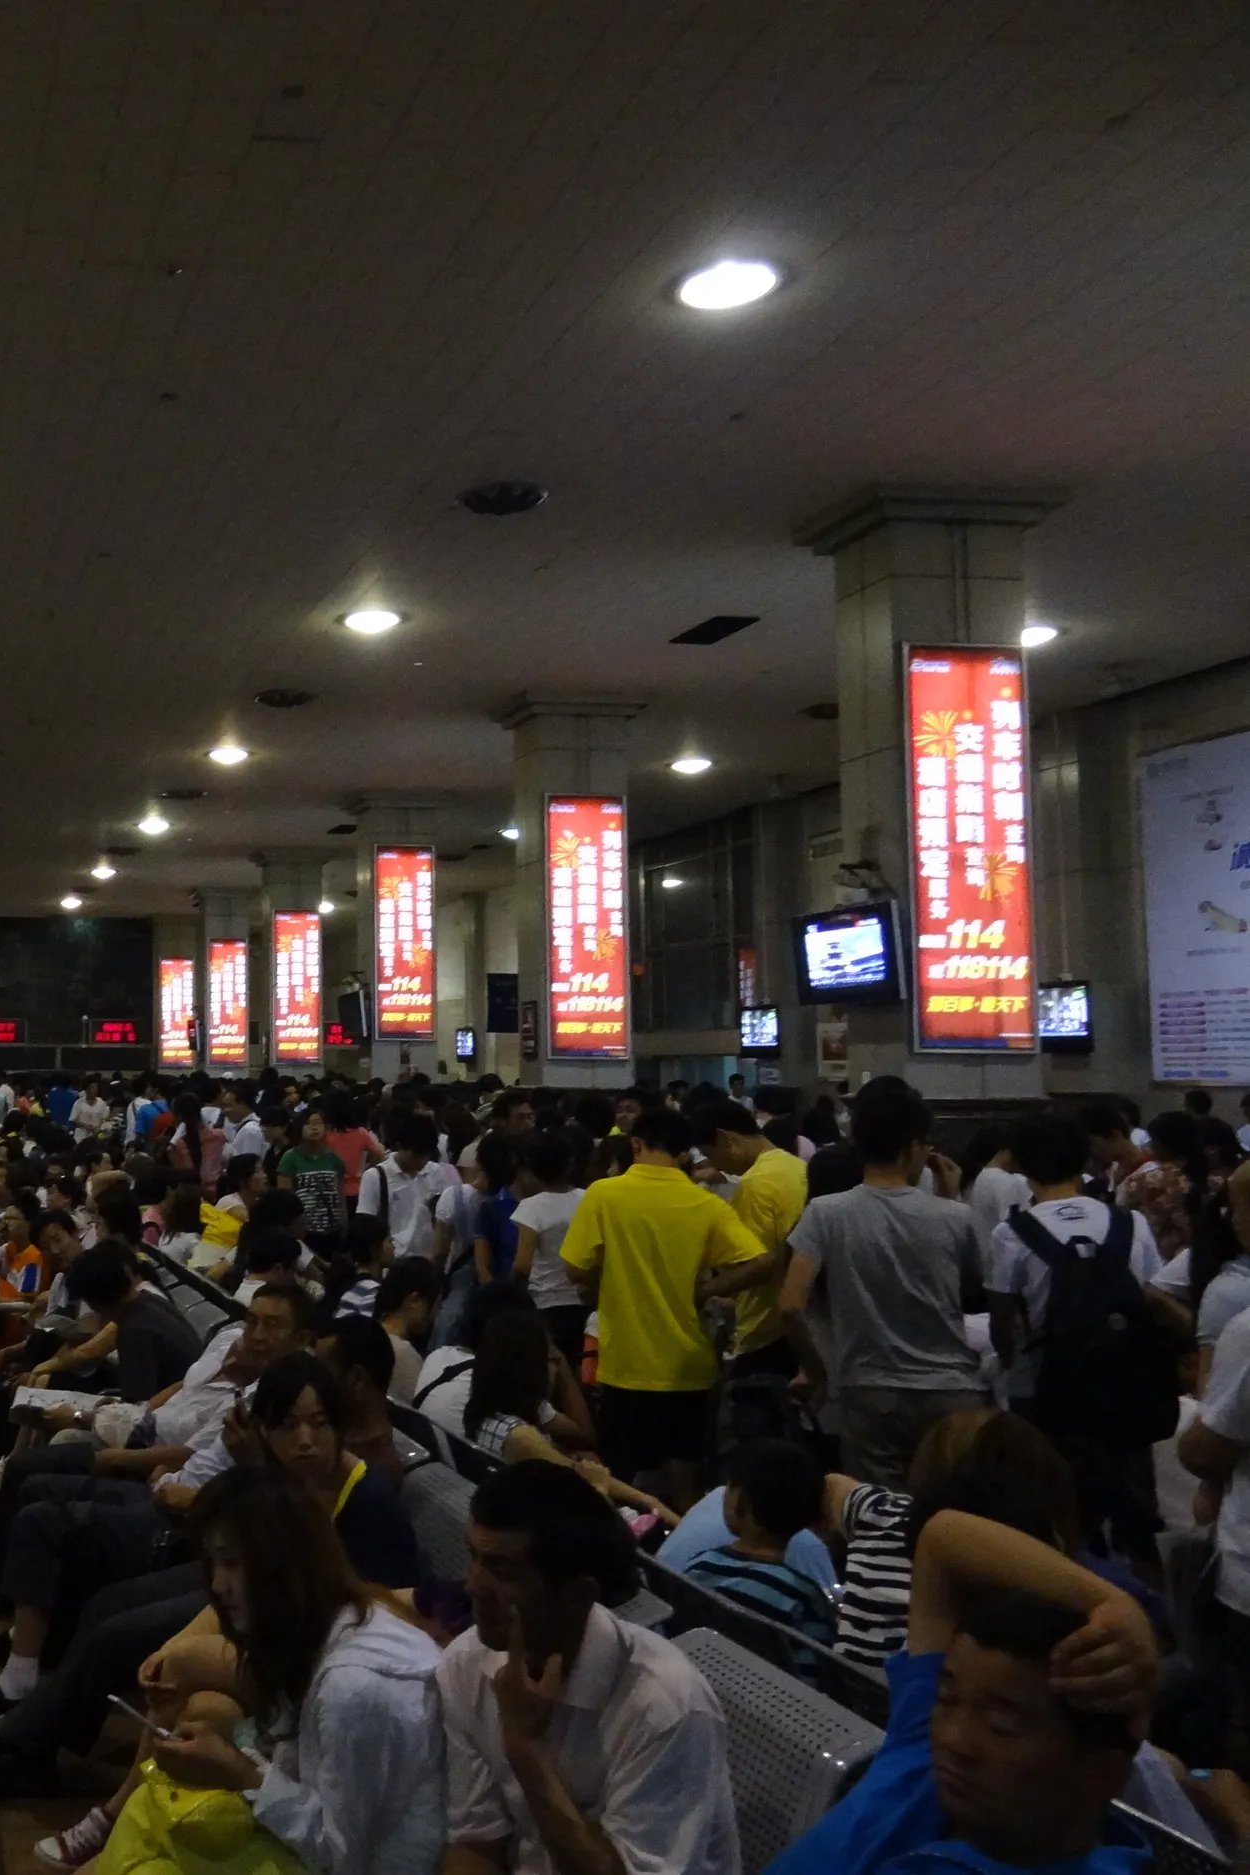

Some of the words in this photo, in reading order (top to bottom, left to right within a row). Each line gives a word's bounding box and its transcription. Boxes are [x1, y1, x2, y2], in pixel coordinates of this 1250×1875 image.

[946, 919, 1007, 949] 114
[391, 976, 421, 991] 114
[569, 973, 609, 992] 114
